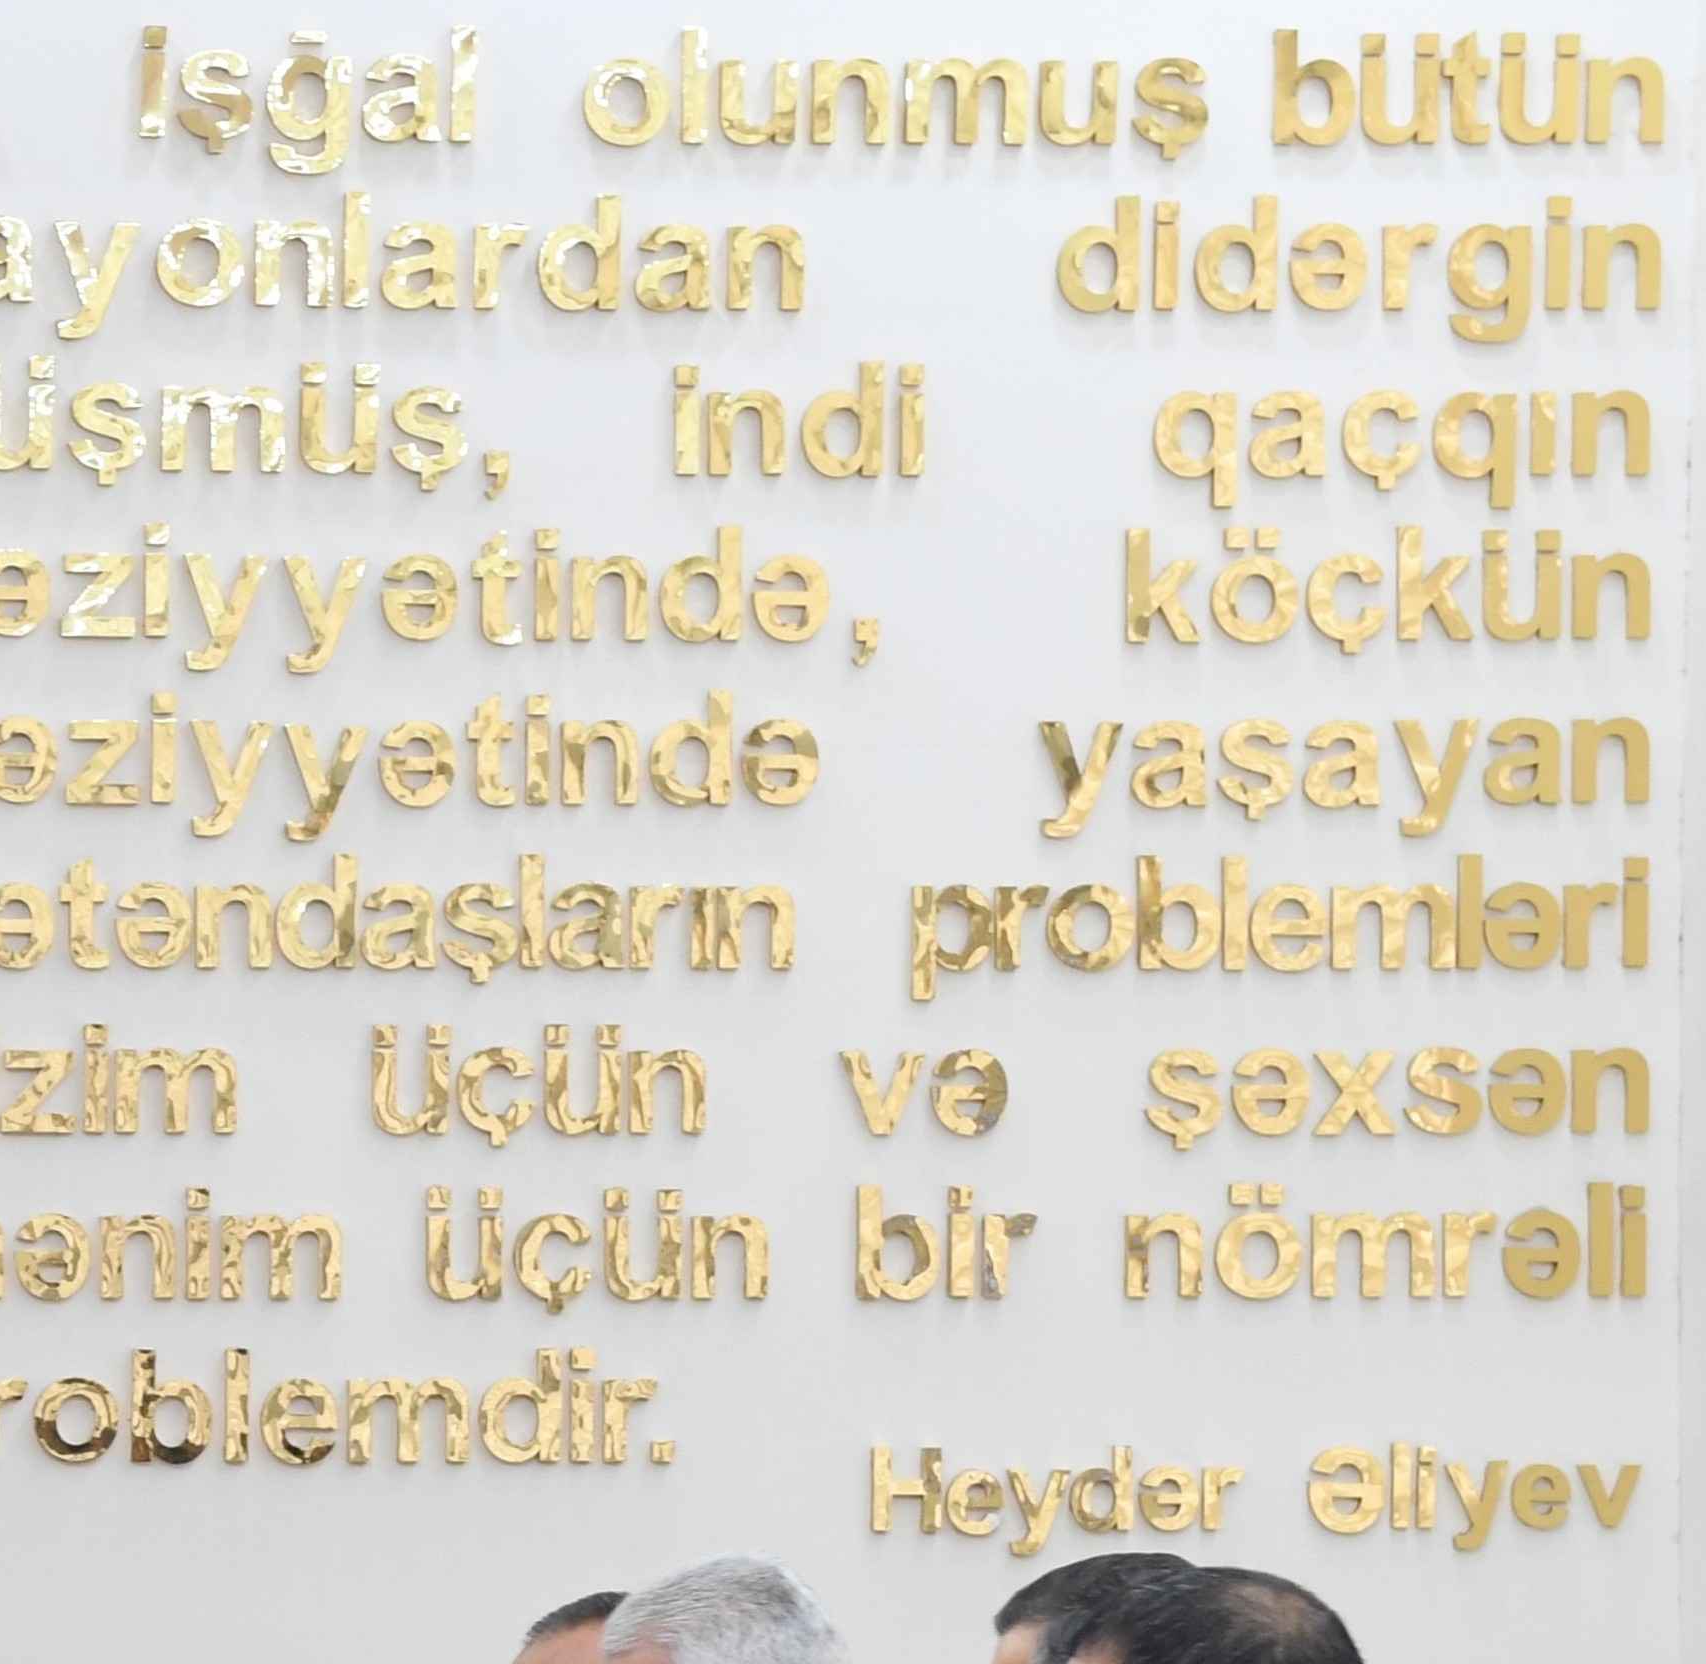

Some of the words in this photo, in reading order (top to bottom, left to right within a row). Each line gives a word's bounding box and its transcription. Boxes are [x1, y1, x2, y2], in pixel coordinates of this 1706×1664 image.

[141, 28, 473, 175] işğal
[584, 32, 1208, 160] olunmuş
[1273, 31, 1665, 147] bütün
[1058, 195, 1661, 344] didərgin
[675, 362, 924, 479] indi
[1154, 390, 1651, 511] qaçqın
[1126, 526, 1652, 655] köçkün
[1040, 718, 1650, 839] yaşayan
[910, 853, 1650, 1002] problemləri
[372, 1024, 706, 1148] üçün
[843, 1050, 1007, 1136] və
[1148, 1047, 1651, 1152] şəxsən
[426, 1187, 769, 1313] üçün
[856, 1185, 1033, 1302] bir
[1124, 1182, 1648, 1301] nömrəli
[870, 1447, 1244, 1559] Heydər
[1308, 1442, 1641, 1552] Əliyev
